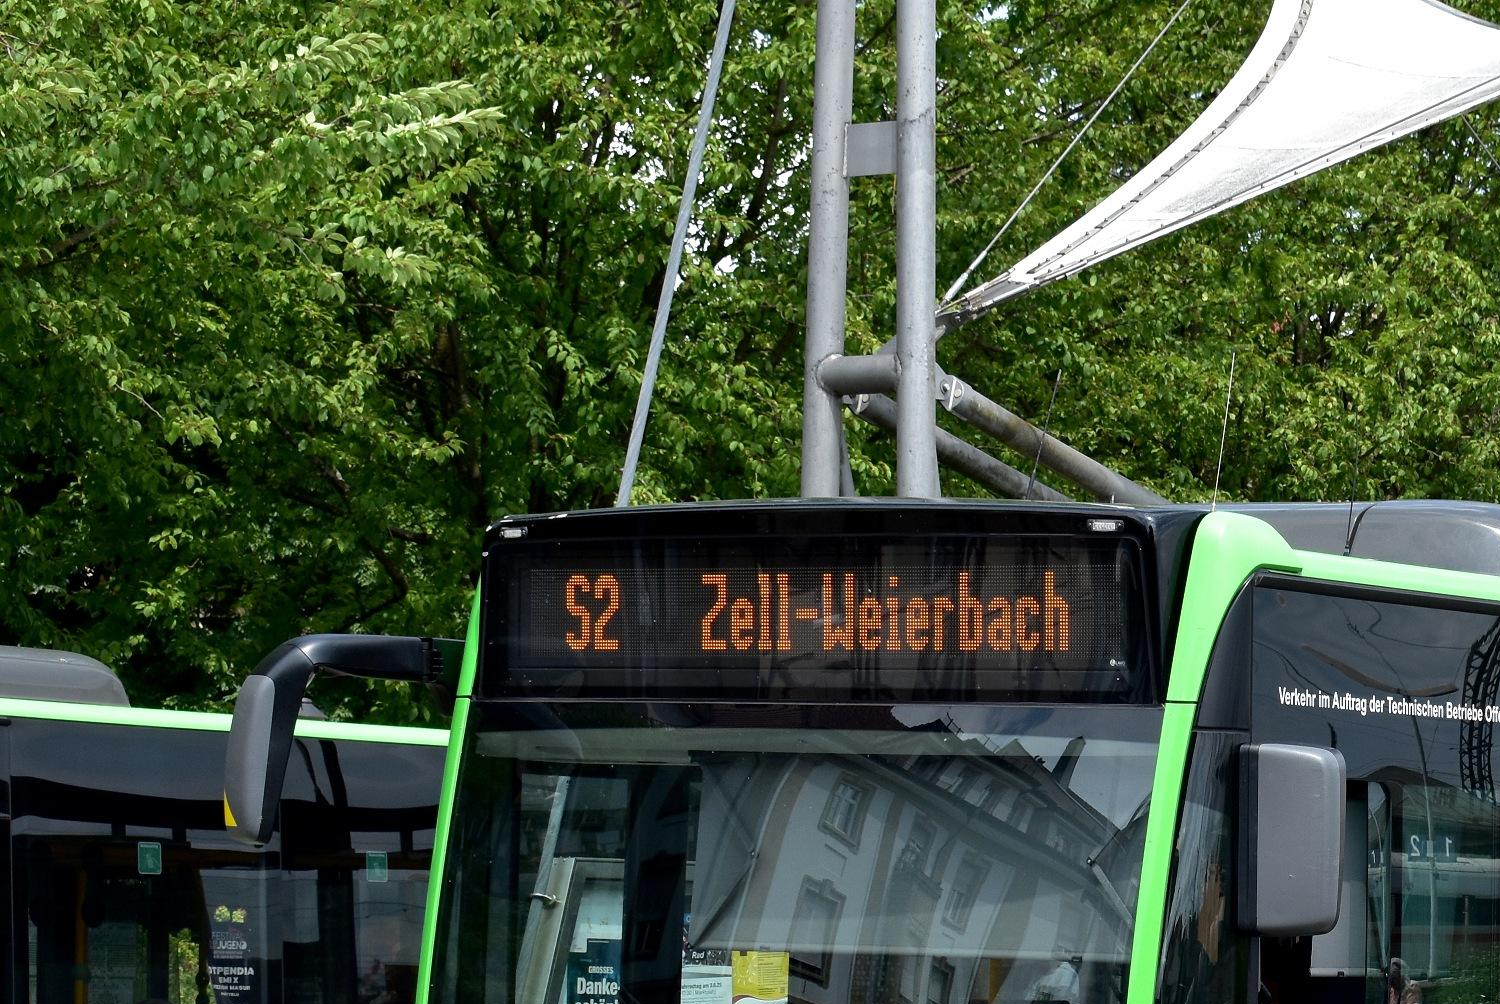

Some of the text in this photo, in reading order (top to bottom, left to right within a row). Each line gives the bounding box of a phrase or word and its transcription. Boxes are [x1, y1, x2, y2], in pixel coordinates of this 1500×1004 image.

[564, 570, 1070, 652] S2 Zell-Weierbach
[1279, 686, 1316, 708] Verkehr
[1318, 690, 1331, 709] im
[1332, 692, 1367, 717] Auftrag
[1369, 695, 1386, 713] der
[1387, 696, 1444, 719] Technischen
[1446, 701, 1484, 722] Betriebe
[588, 965, 614, 974] GROSSES
